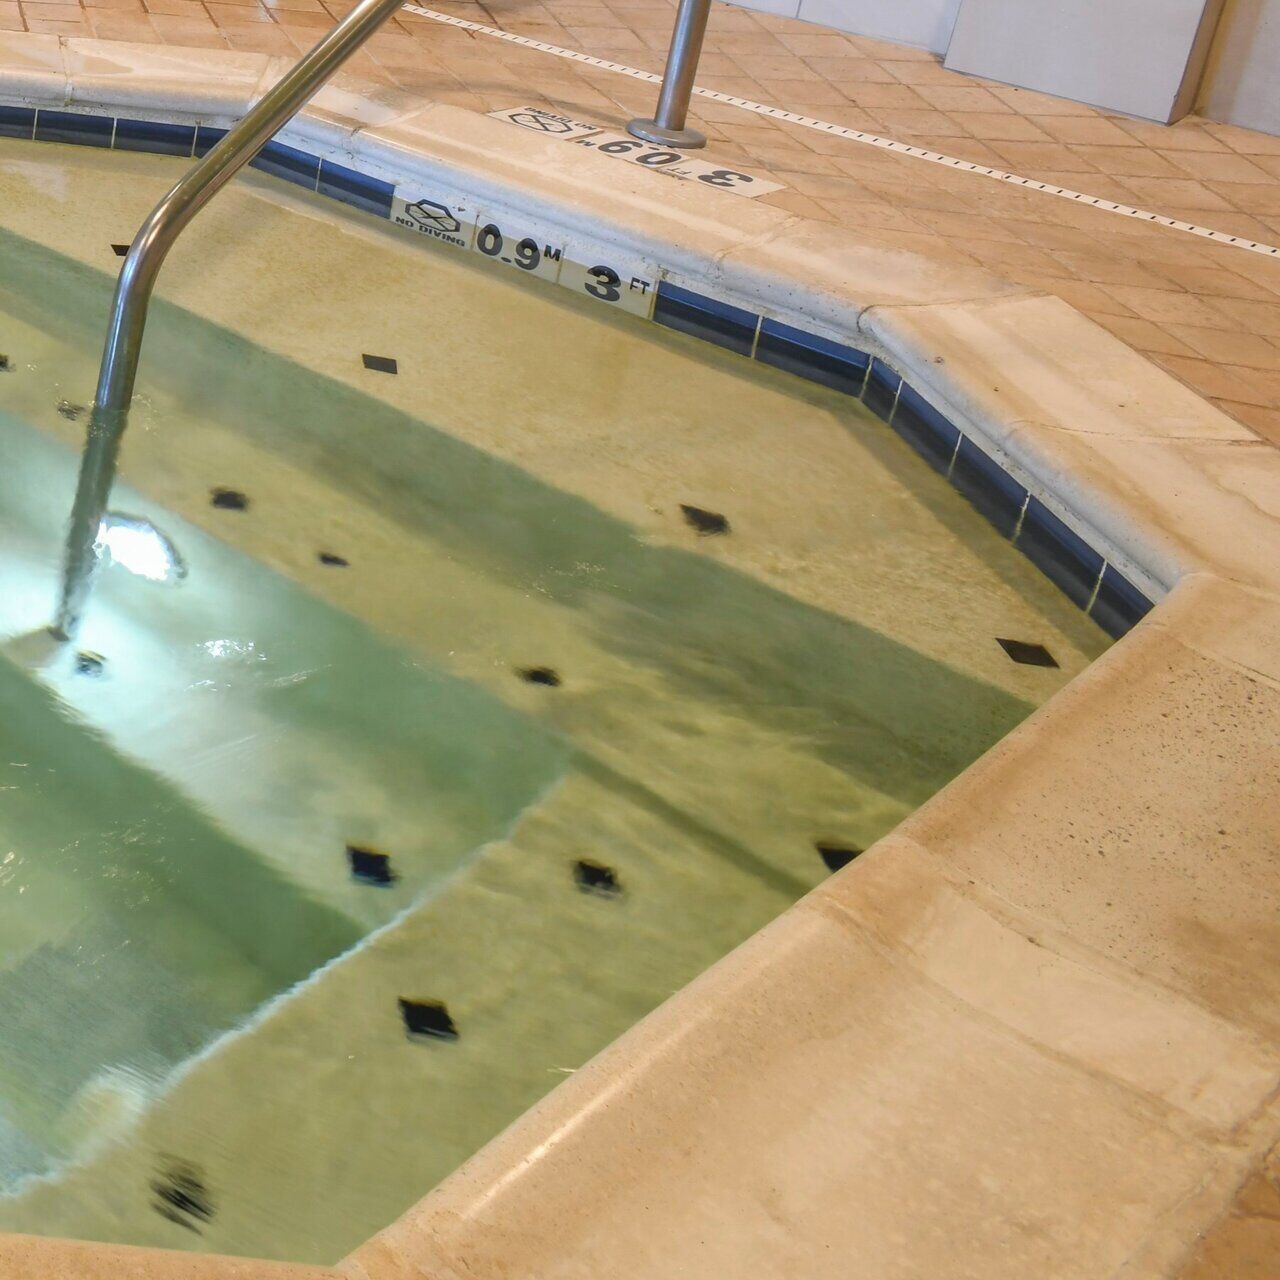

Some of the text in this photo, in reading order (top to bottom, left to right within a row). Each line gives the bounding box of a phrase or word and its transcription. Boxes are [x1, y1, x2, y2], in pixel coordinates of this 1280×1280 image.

[698, 169, 753, 188] 3
[395, 216, 466, 248] NO DIVING
[584, 265, 621, 303] 3
